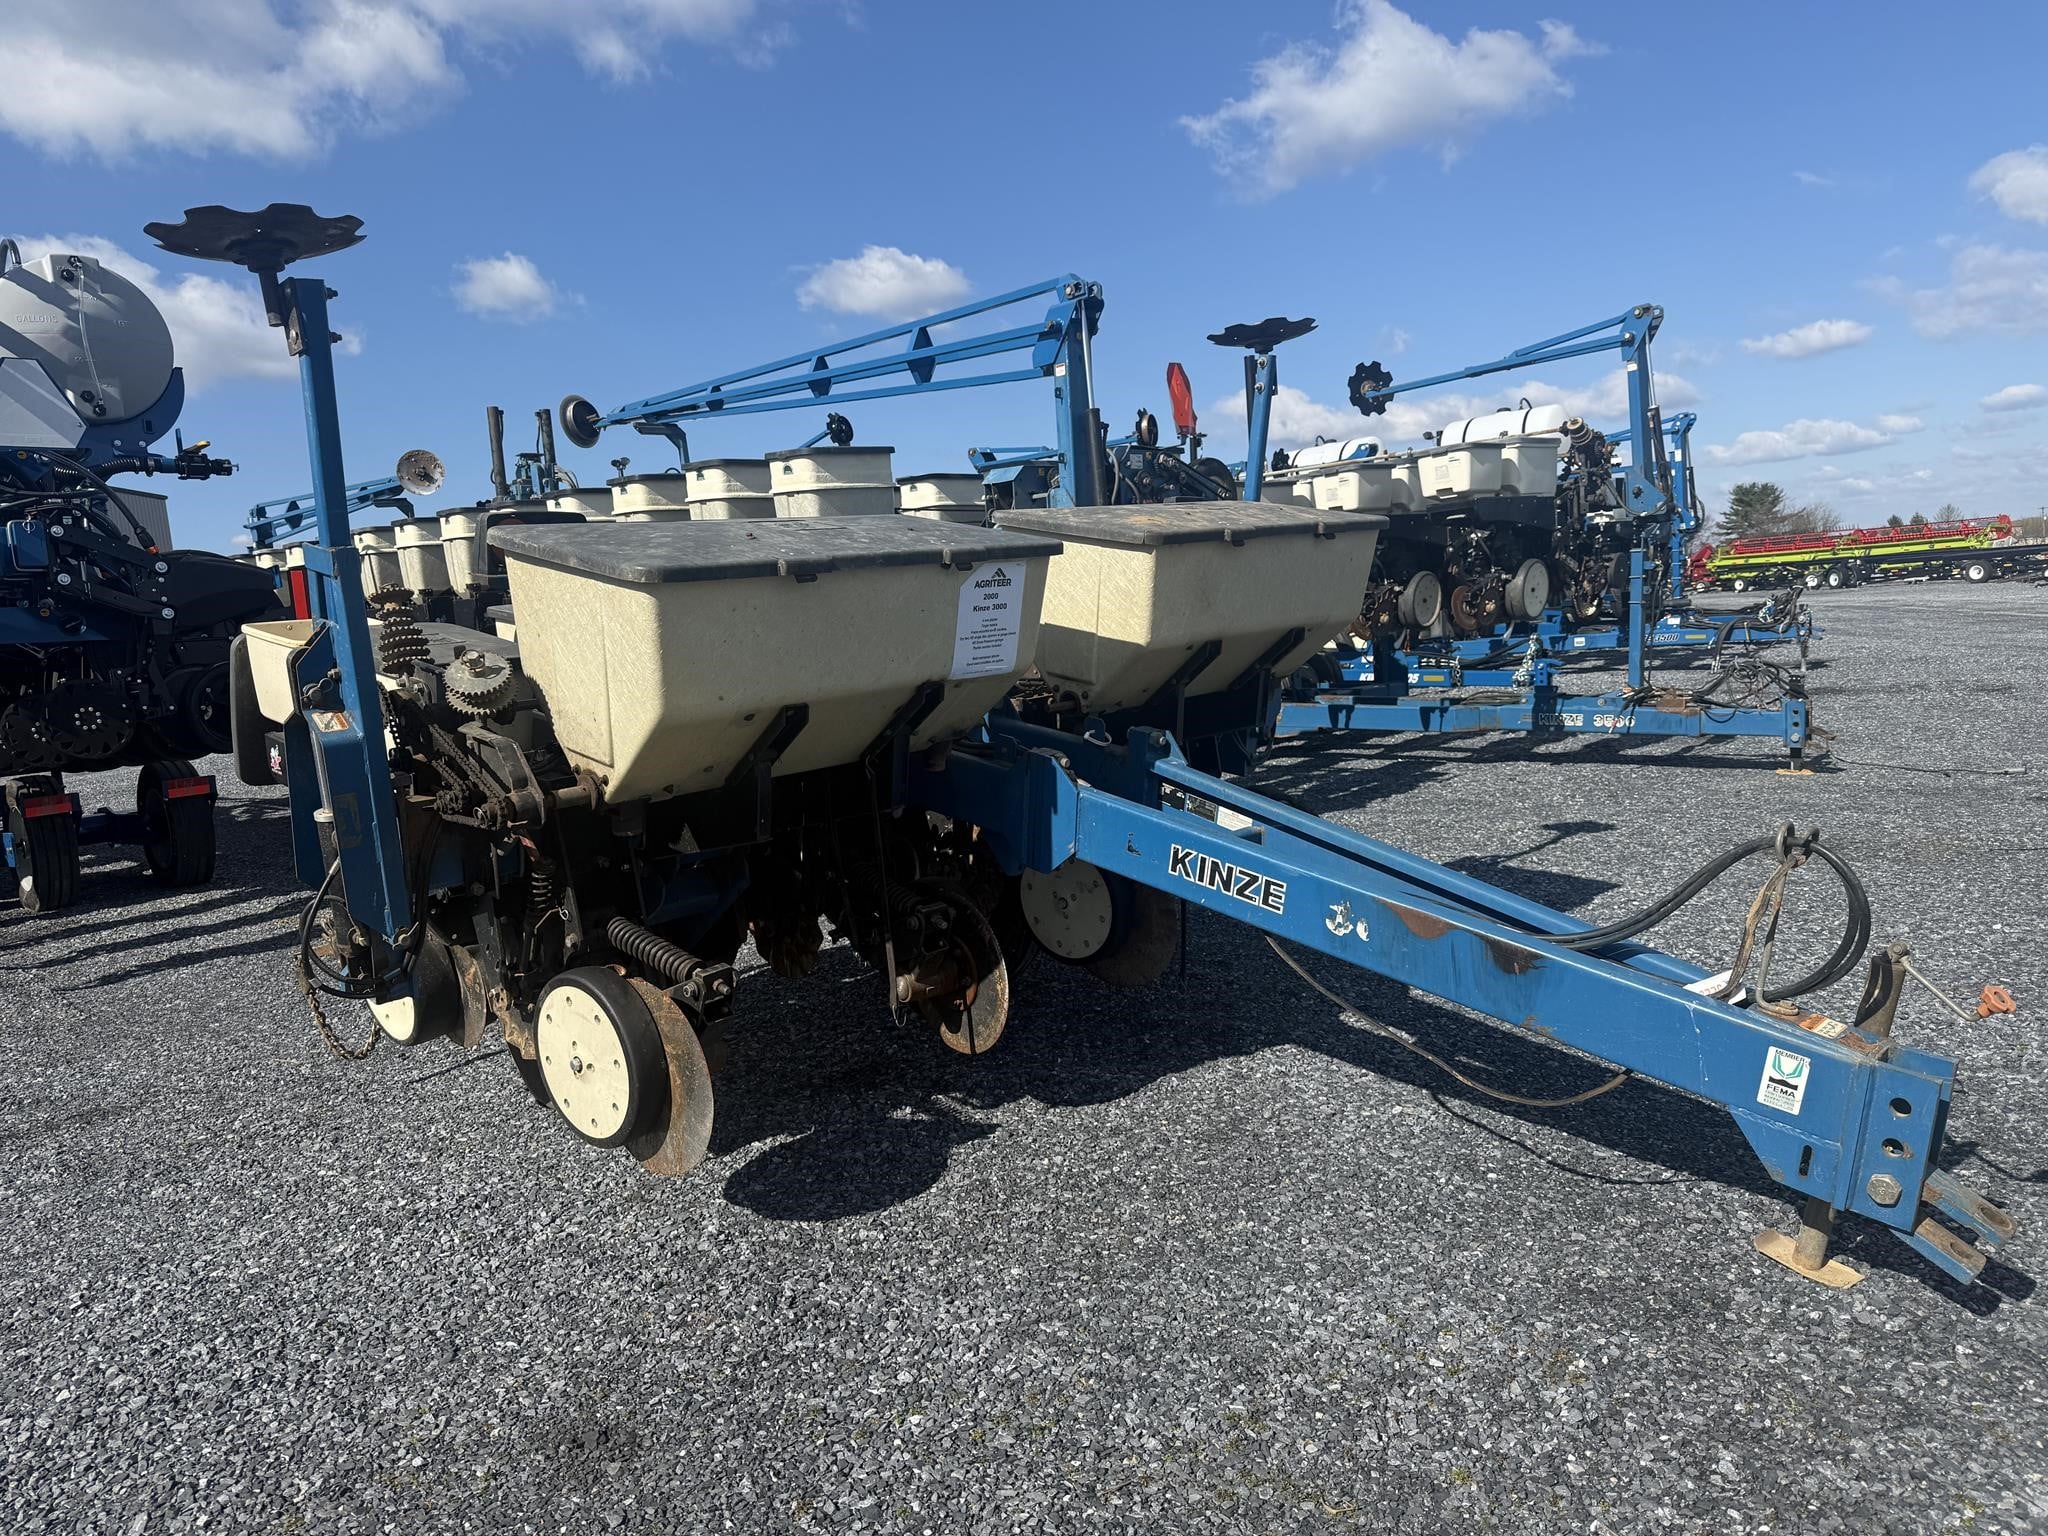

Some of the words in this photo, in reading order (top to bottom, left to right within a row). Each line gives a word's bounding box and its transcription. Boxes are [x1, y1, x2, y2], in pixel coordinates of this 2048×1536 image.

[974, 579, 1012, 589] AGRITEER
[973, 604, 991, 612] Kinze
[1654, 633, 1680, 642] 3500
[1538, 713, 1584, 726] KINZE
[1168, 843, 1287, 915] KINZE
[1775, 1049, 1805, 1062] MEMBER
[1766, 1083, 1796, 1099] FEMA
